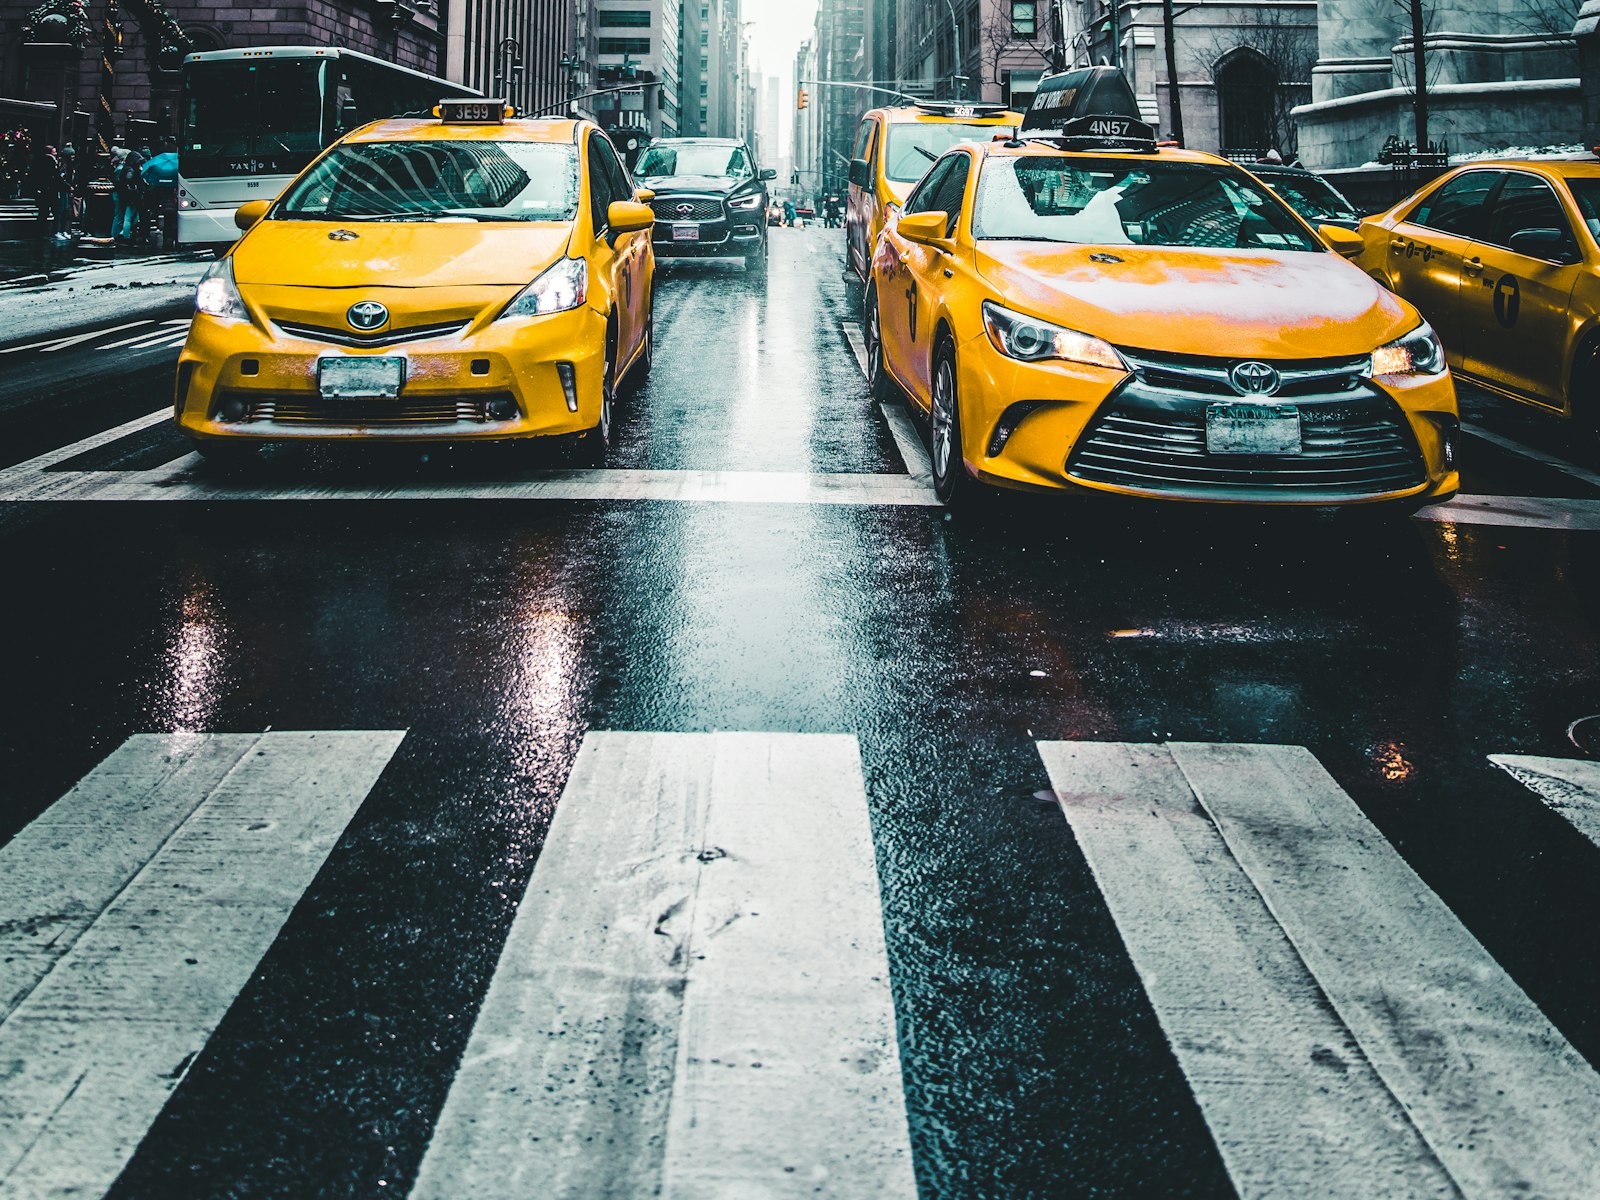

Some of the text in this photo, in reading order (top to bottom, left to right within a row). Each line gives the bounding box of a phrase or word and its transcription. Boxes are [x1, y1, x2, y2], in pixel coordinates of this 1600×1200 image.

[1031, 92, 1049, 110] NEW
[455, 104, 489, 120] 3E99
[1088, 120, 1130, 135] 4N57
[1501, 284, 1515, 320] T
[1229, 409, 1276, 419] NEW YORK
